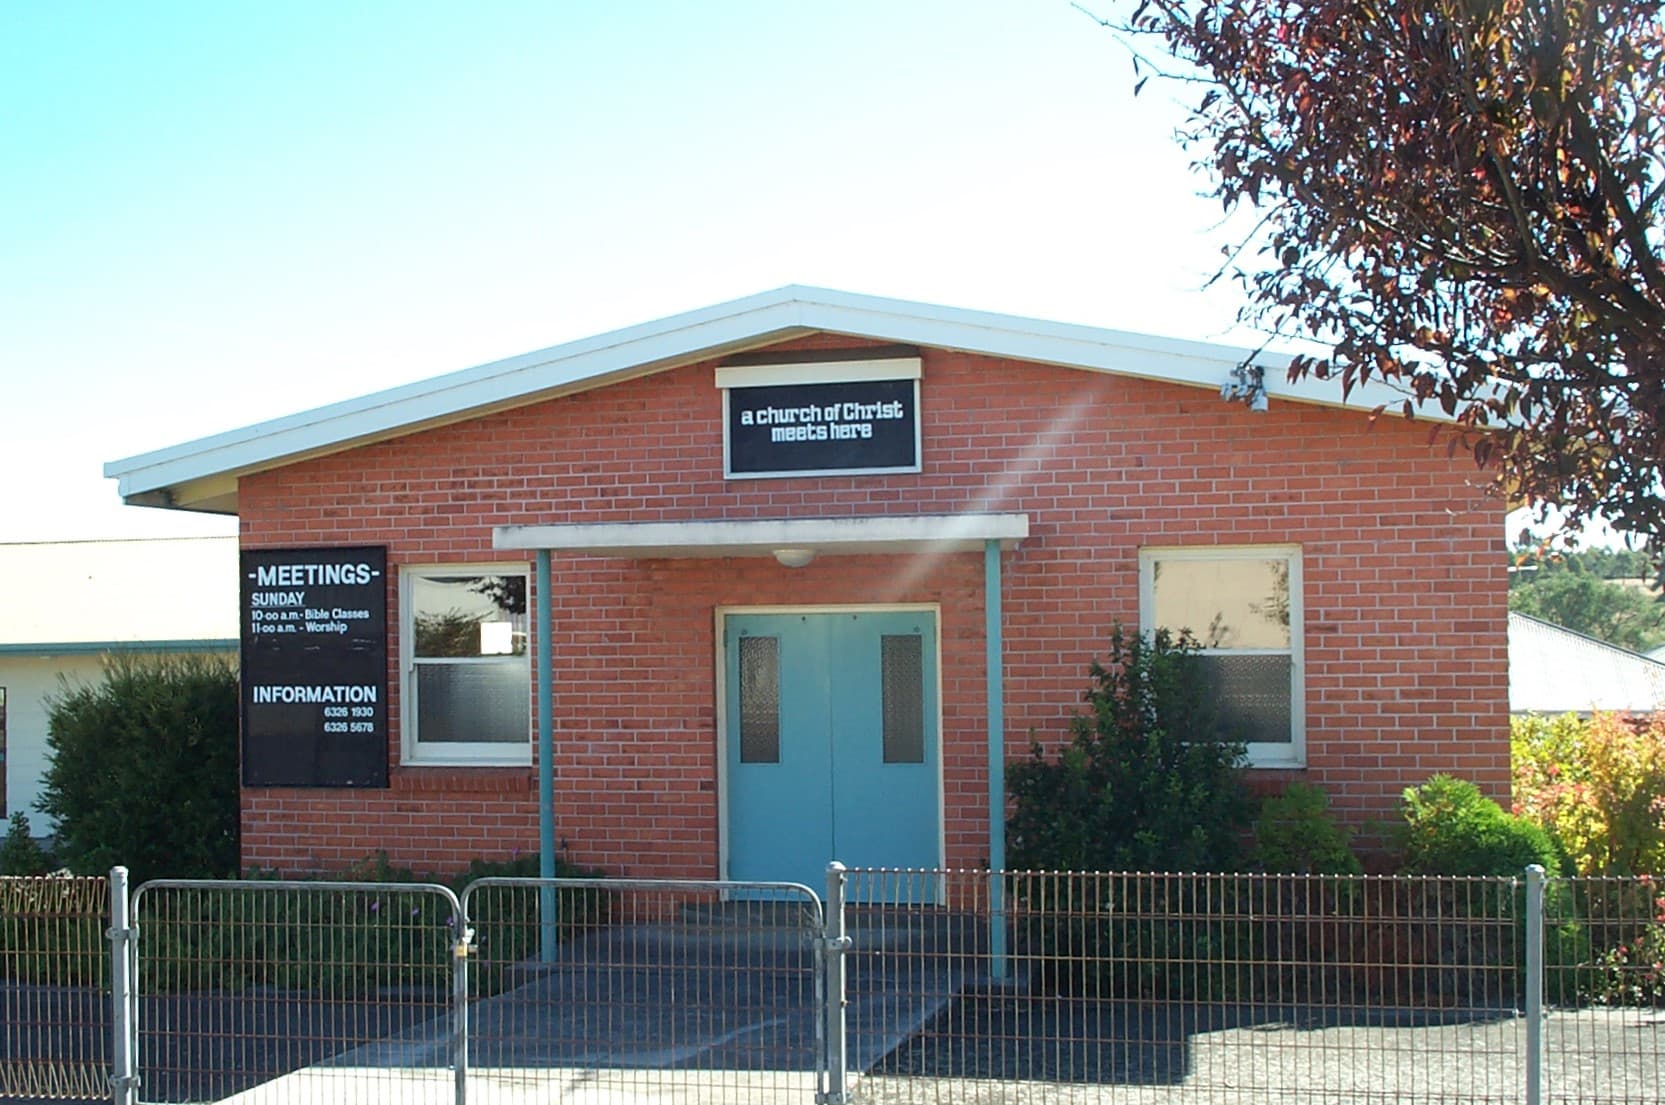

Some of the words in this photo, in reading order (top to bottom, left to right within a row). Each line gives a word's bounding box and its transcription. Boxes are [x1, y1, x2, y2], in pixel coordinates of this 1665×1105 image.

[741, 410, 753, 425] a
[756, 404, 821, 424] church
[824, 403, 841, 421] of
[843, 400, 903, 421] Christ
[771, 423, 827, 442] meets
[830, 422, 872, 440] here
[251, 592, 305, 606] SUNDAY
[304, 608, 330, 620] Bible
[332, 607, 370, 619] Classes
[305, 621, 348, 635] Worship
[253, 685, 377, 703] INFORMATION
